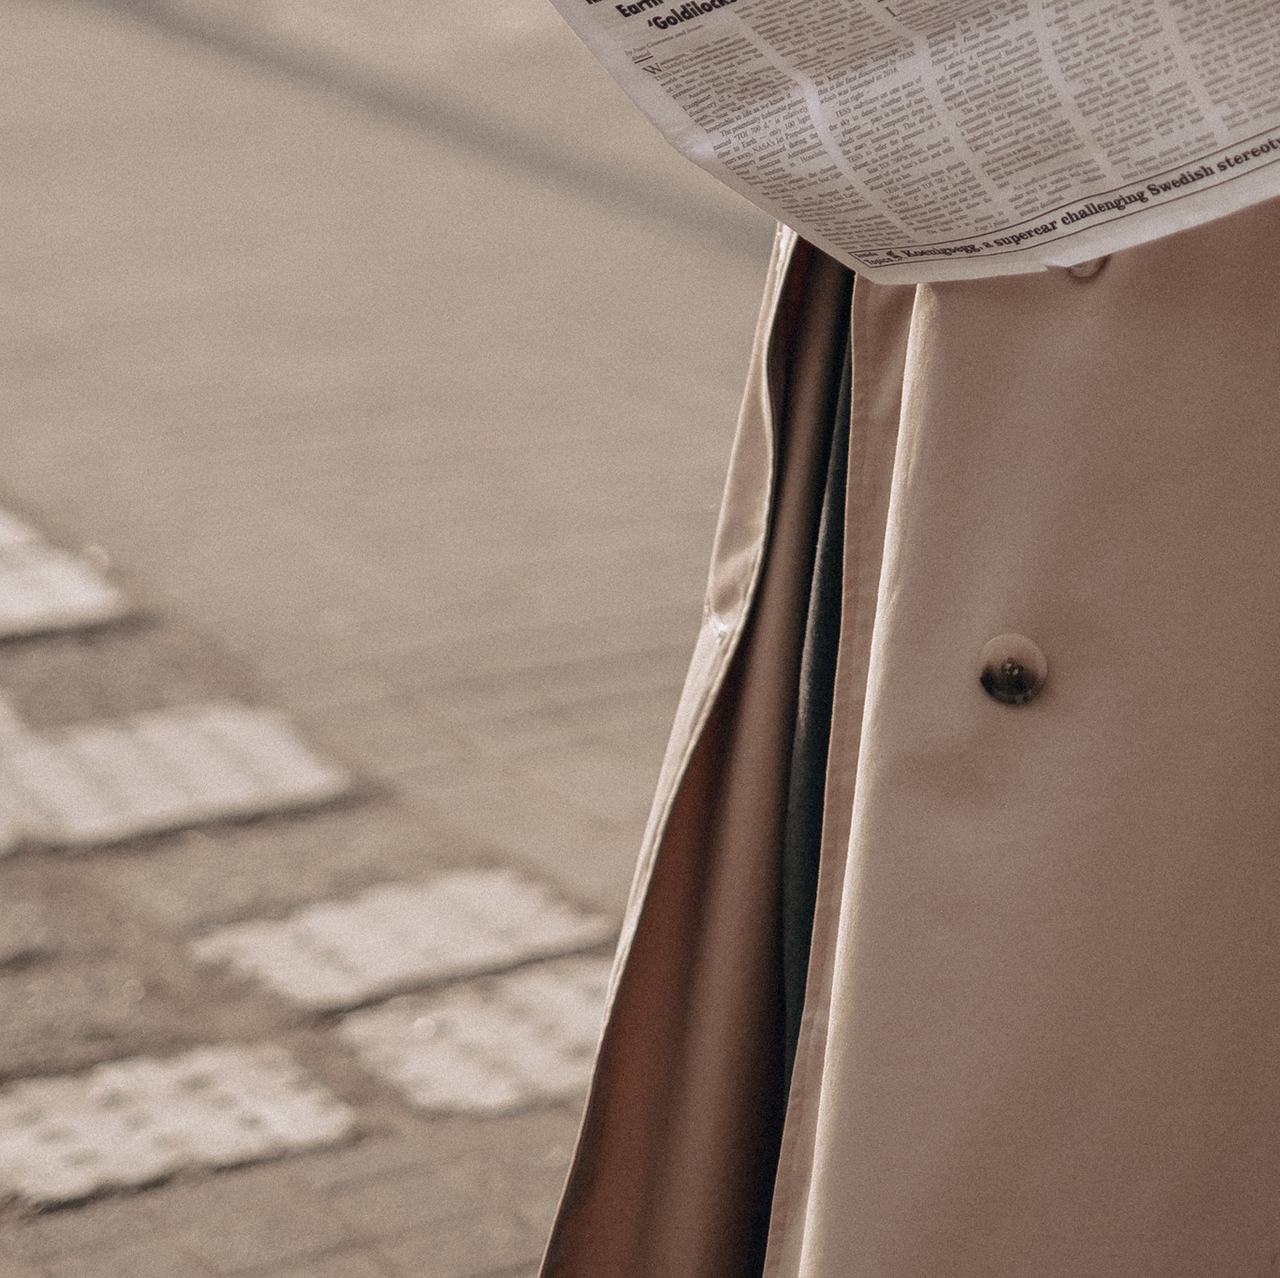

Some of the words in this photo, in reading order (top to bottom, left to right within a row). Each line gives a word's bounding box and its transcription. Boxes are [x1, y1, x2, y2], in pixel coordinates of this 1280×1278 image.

[994, 219, 1058, 247] supercar
[1060, 188, 1149, 226] challenging
[1146, 164, 1216, 196] Swedish
